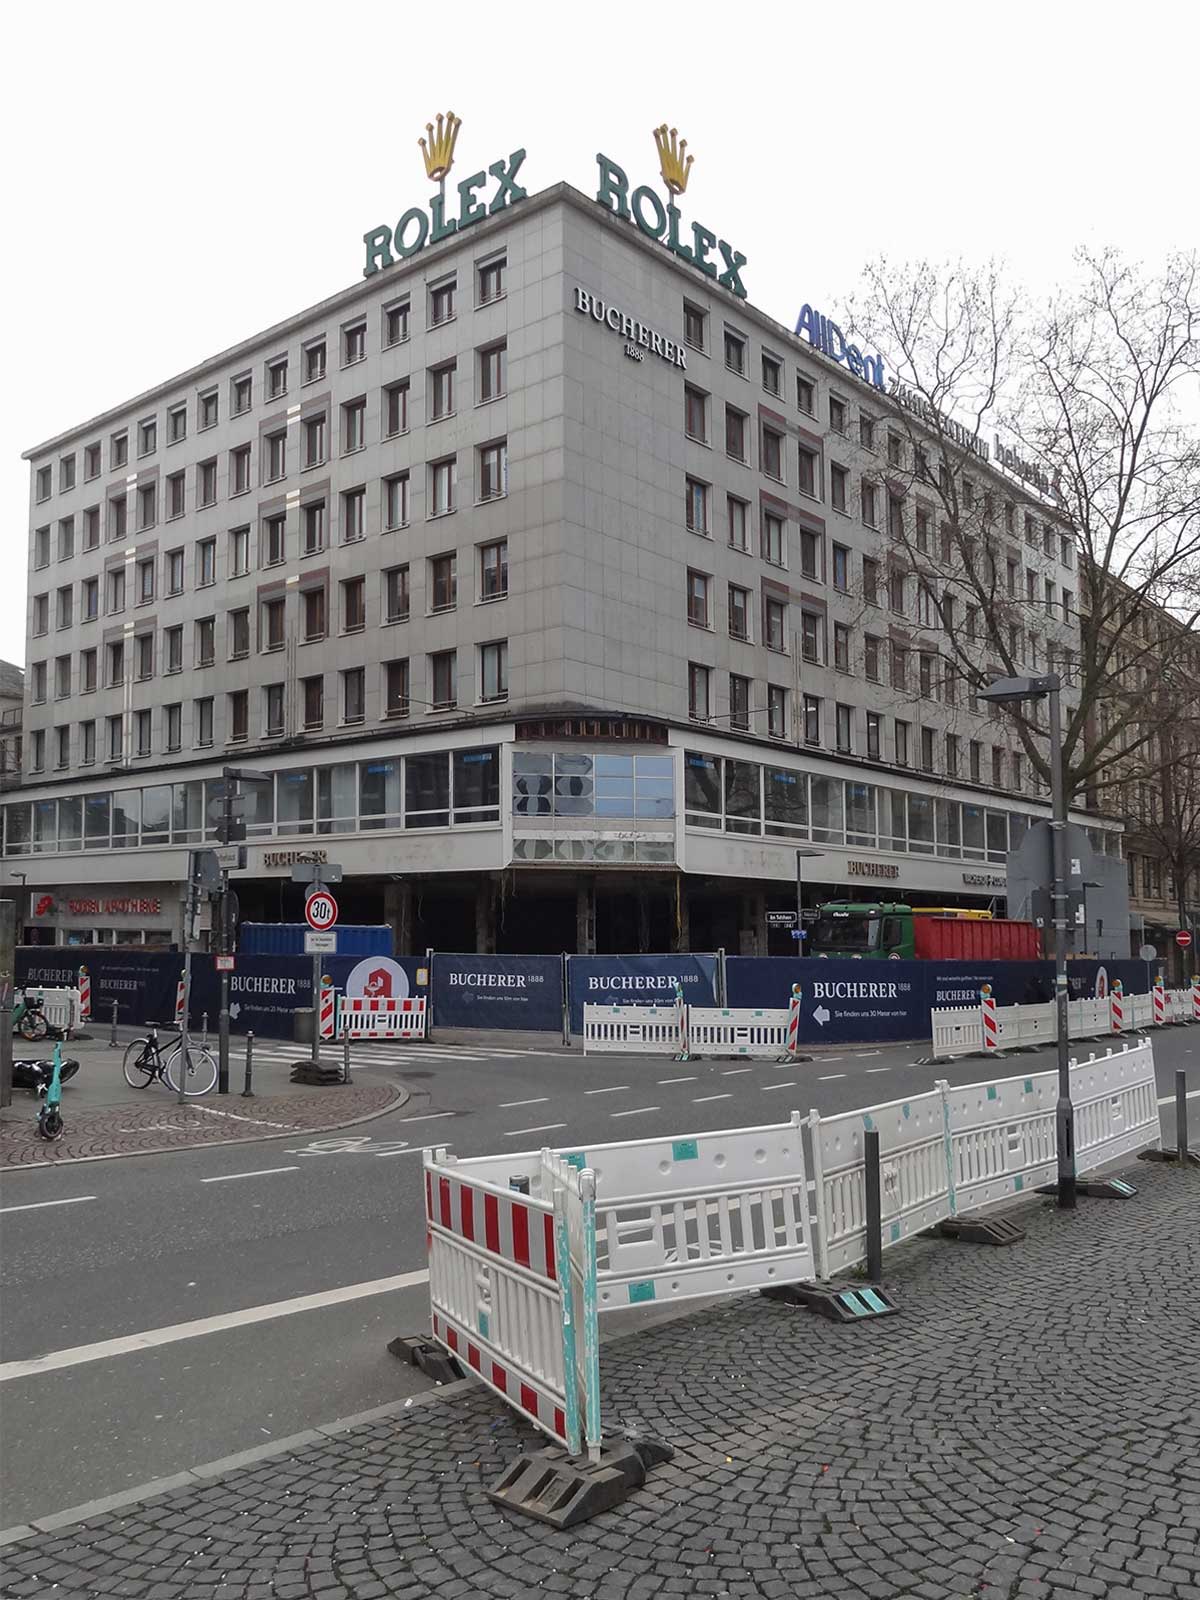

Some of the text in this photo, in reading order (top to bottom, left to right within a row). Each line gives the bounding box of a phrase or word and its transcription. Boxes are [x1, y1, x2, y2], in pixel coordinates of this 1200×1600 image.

[363, 148, 528, 279] ROLEX
[596, 153, 747, 299] ROLEX
[575, 287, 687, 370] BUCHERER
[624, 344, 645, 362] 1888
[795, 303, 885, 392] AllDent
[848, 861, 899, 879] BUCHERER
[28, 967, 74, 983] BUCHERER
[449, 973, 545, 988] BUCHERER 1888
[588, 975, 699, 990] BUCHERER 1888
[99, 978, 138, 991] BUCHERER
[231, 976, 296, 994] BUCHERER
[813, 982, 898, 999] BUCHERER
[936, 989, 976, 1001] BUCHERER
